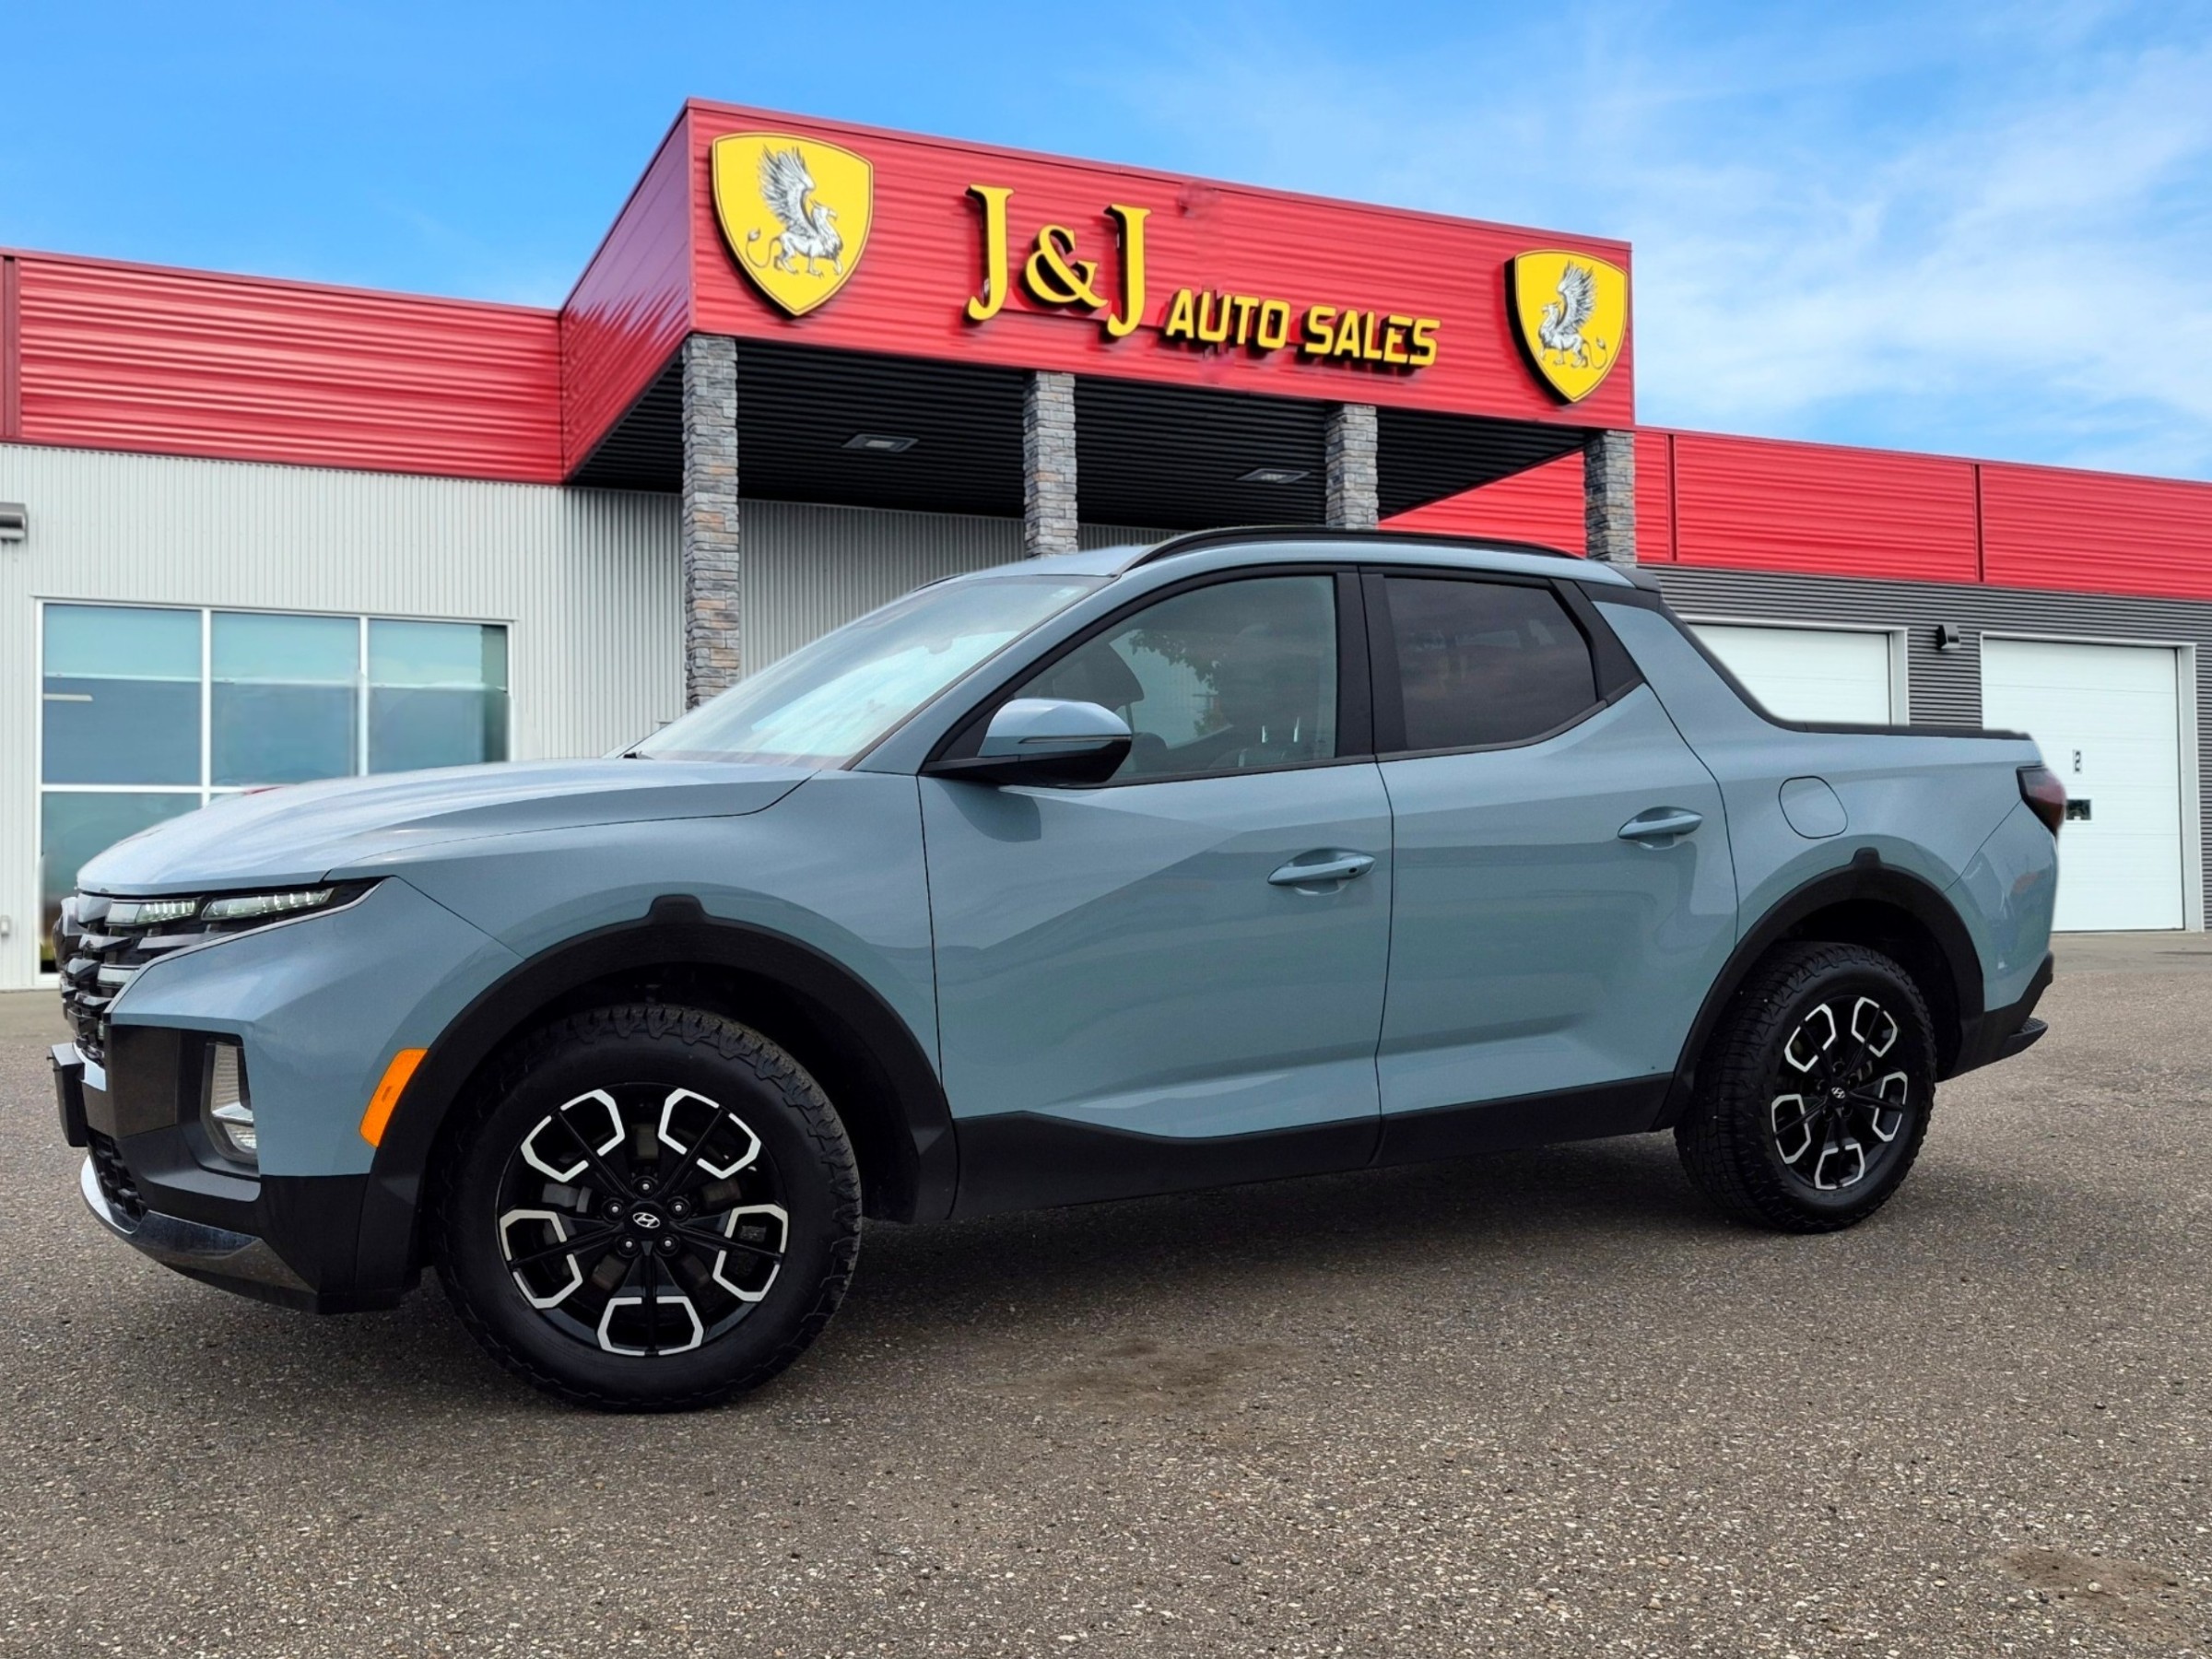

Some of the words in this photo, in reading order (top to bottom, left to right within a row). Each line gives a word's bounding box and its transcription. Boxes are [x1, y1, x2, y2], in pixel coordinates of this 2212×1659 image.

[968, 185, 1151, 336] J&J
[1167, 288, 1290, 349] AUTO
[1305, 306, 1441, 366] SALES
